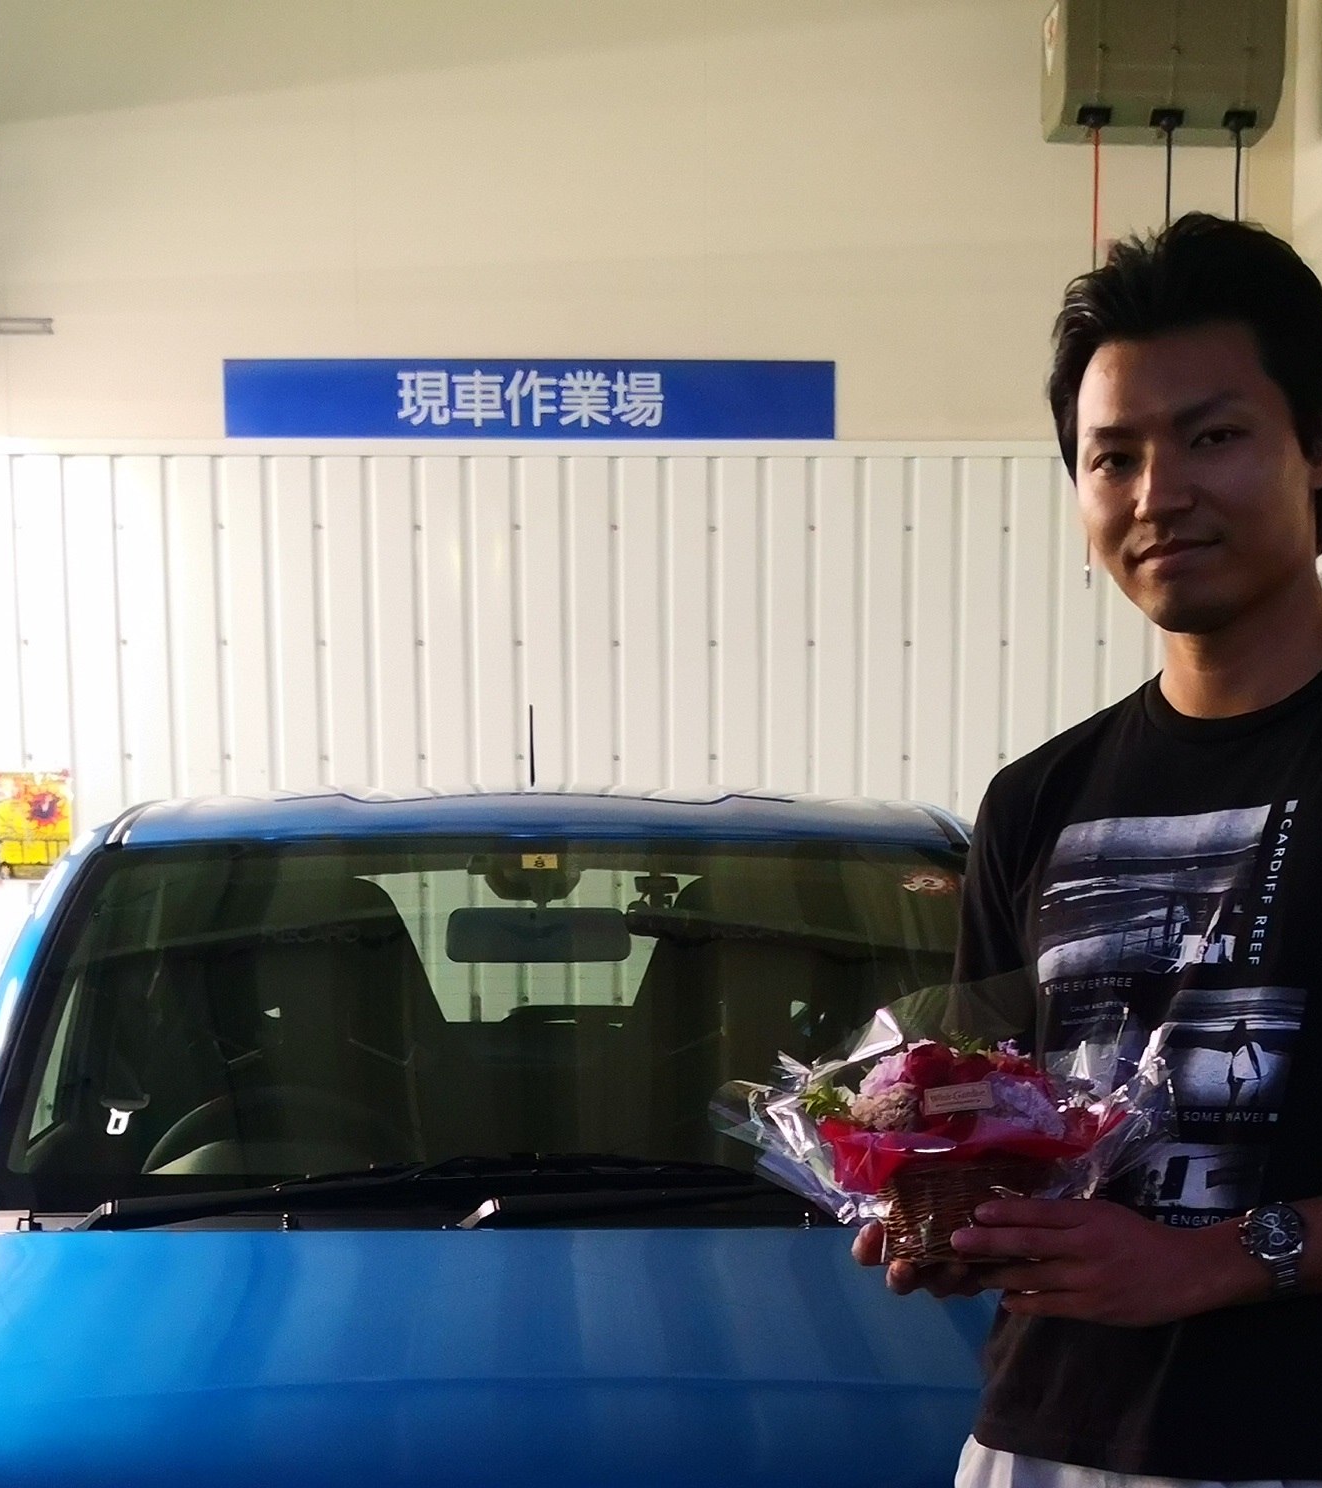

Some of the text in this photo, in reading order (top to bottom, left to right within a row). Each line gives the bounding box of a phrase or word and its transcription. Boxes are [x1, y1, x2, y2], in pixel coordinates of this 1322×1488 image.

[397, 369, 665, 428] 現車作業場
[1247, 818, 1294, 966] CARDIFF REEF
[1049, 982, 1070, 994] THE
[1182, 1111, 1222, 1123] SOME
